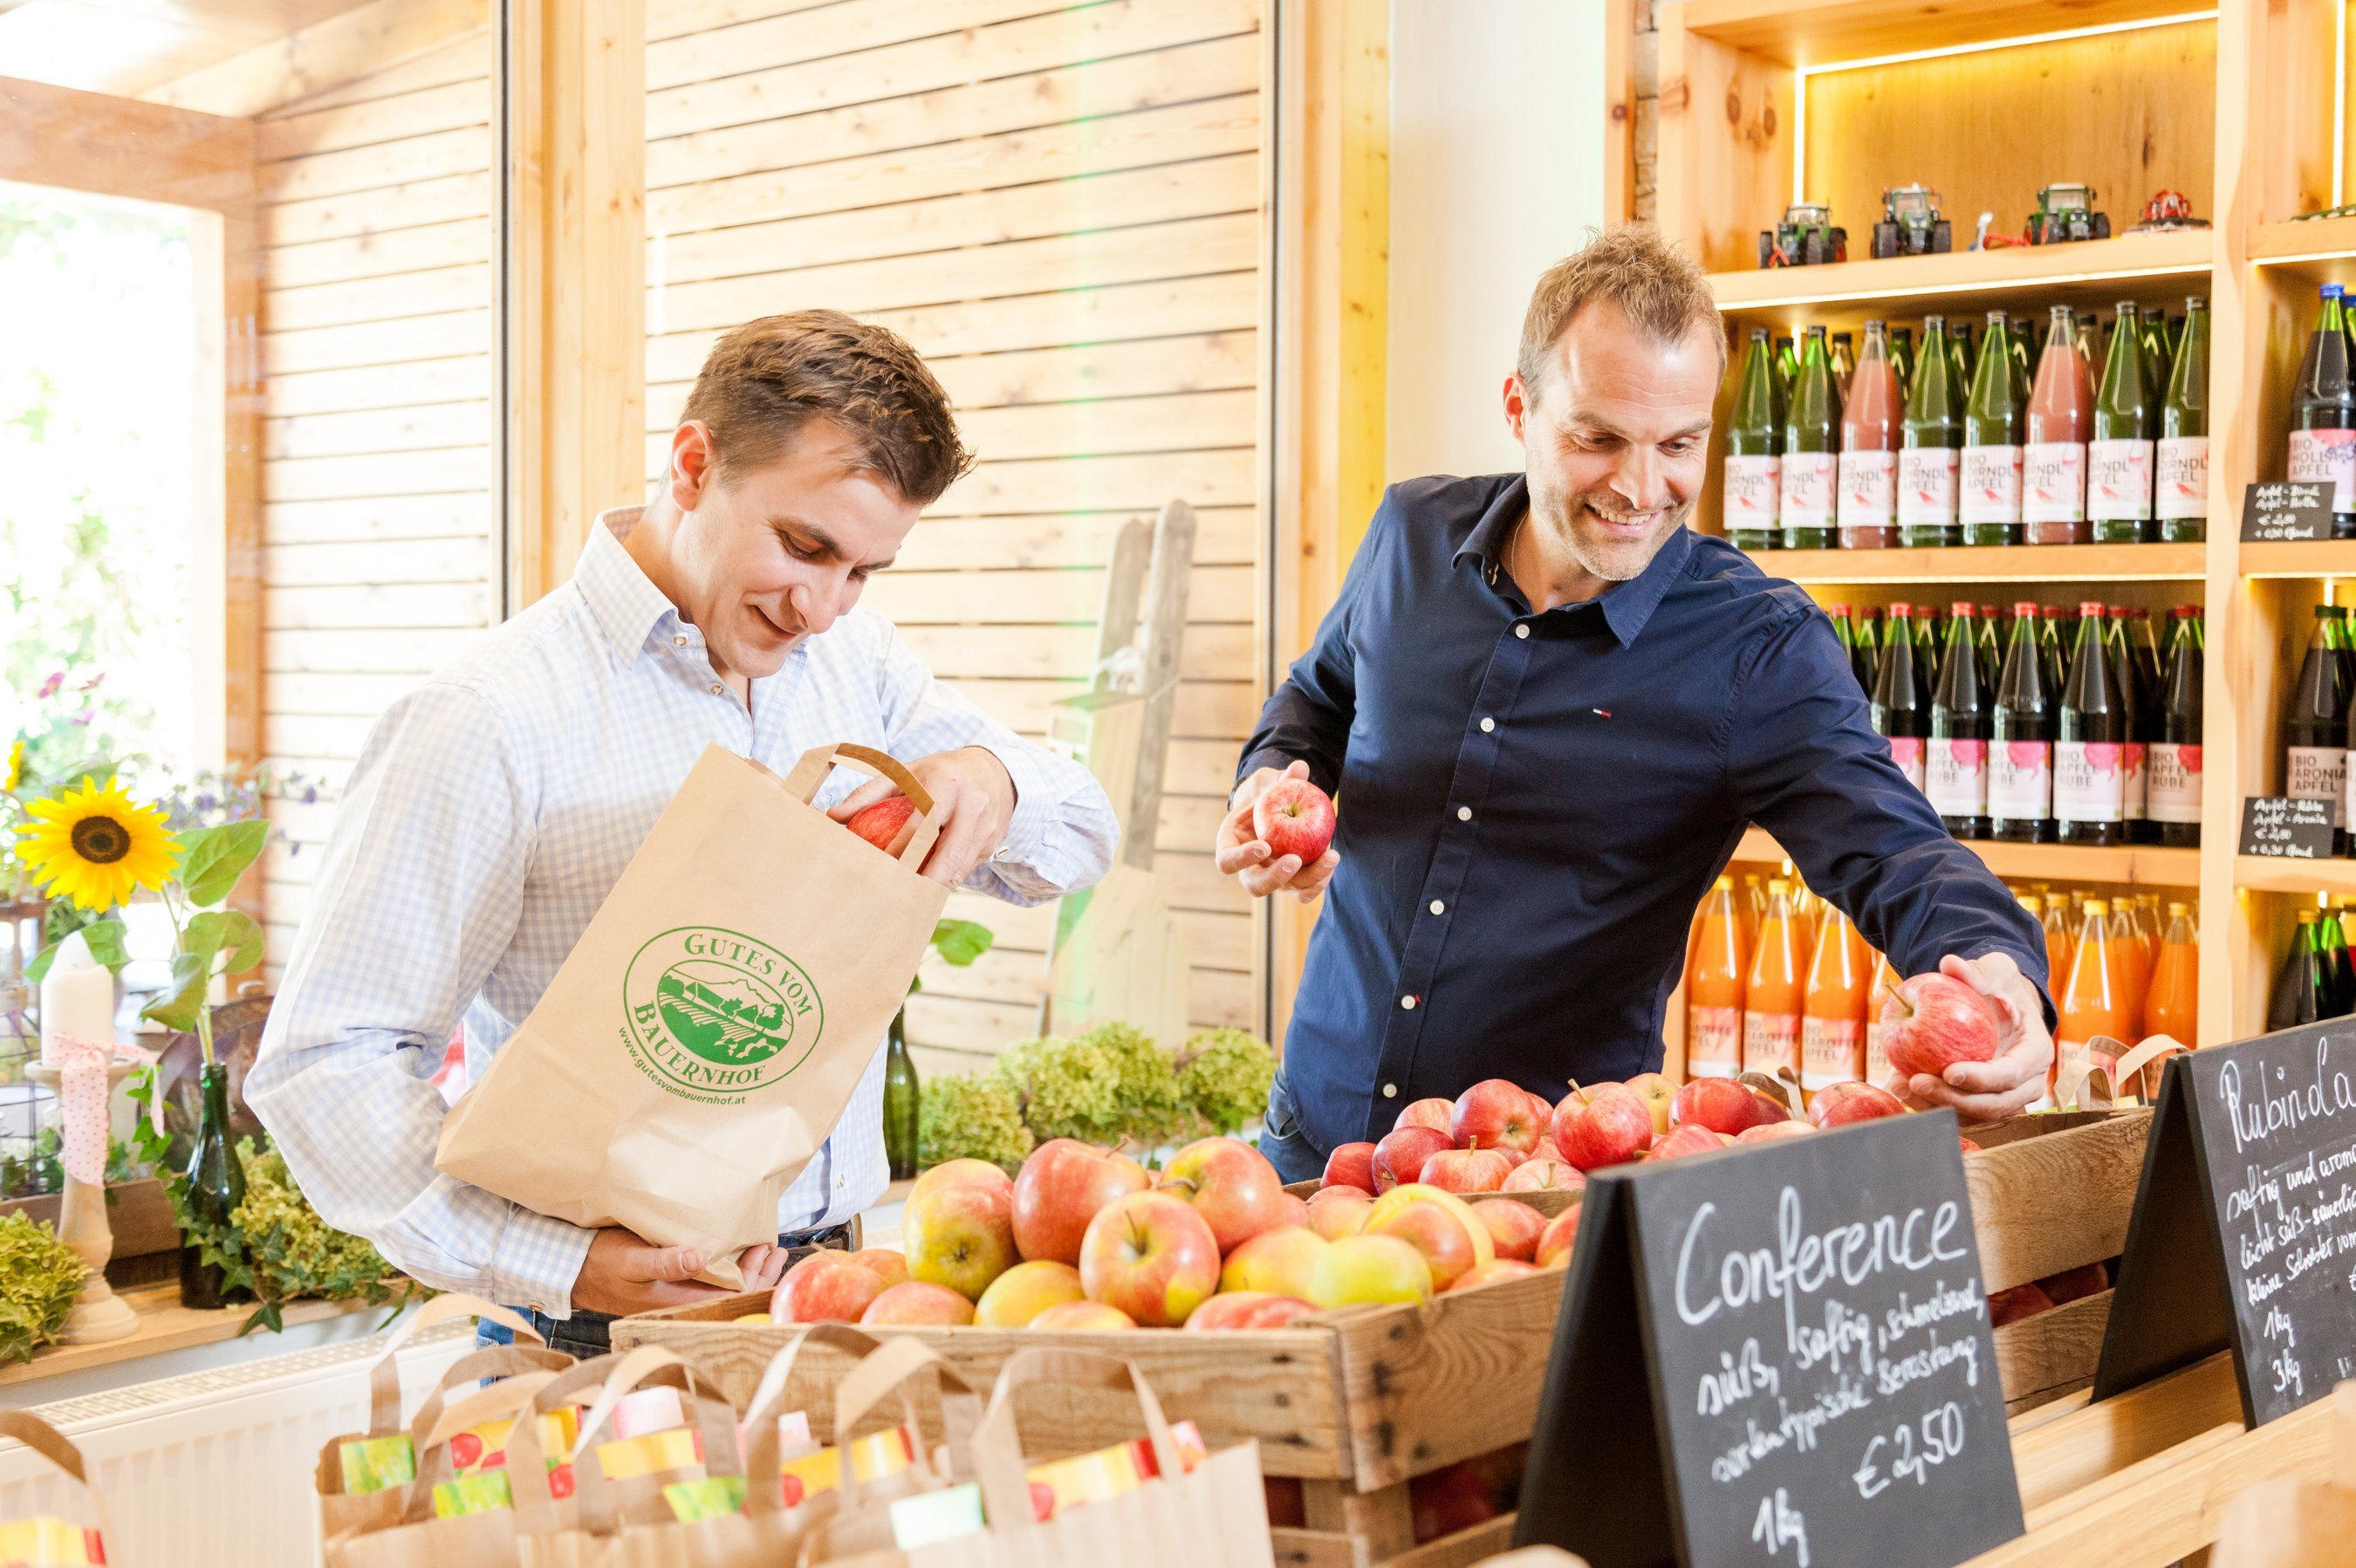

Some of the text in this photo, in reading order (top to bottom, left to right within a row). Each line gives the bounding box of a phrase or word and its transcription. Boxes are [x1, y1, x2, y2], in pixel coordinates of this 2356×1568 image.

[2293, 438, 2312, 451] BIO
[2292, 463, 2332, 476] APFEL
[2294, 768, 2346, 780] ARONIA
[2295, 756, 2317, 767] BIO
[2294, 780, 2338, 793] APFEL
[684, 933, 813, 1017] GUTES VOM
[634, 1000, 767, 1086] BAUERNHOF
[618, 1026, 746, 1106] www.gutesvombauernhof.at
[2286, 1149, 2318, 1191] und
[1674, 1184, 1968, 1354] Conference
[2264, 1305, 2296, 1348] 1kg
[2272, 1348, 2304, 1398] 3kg
